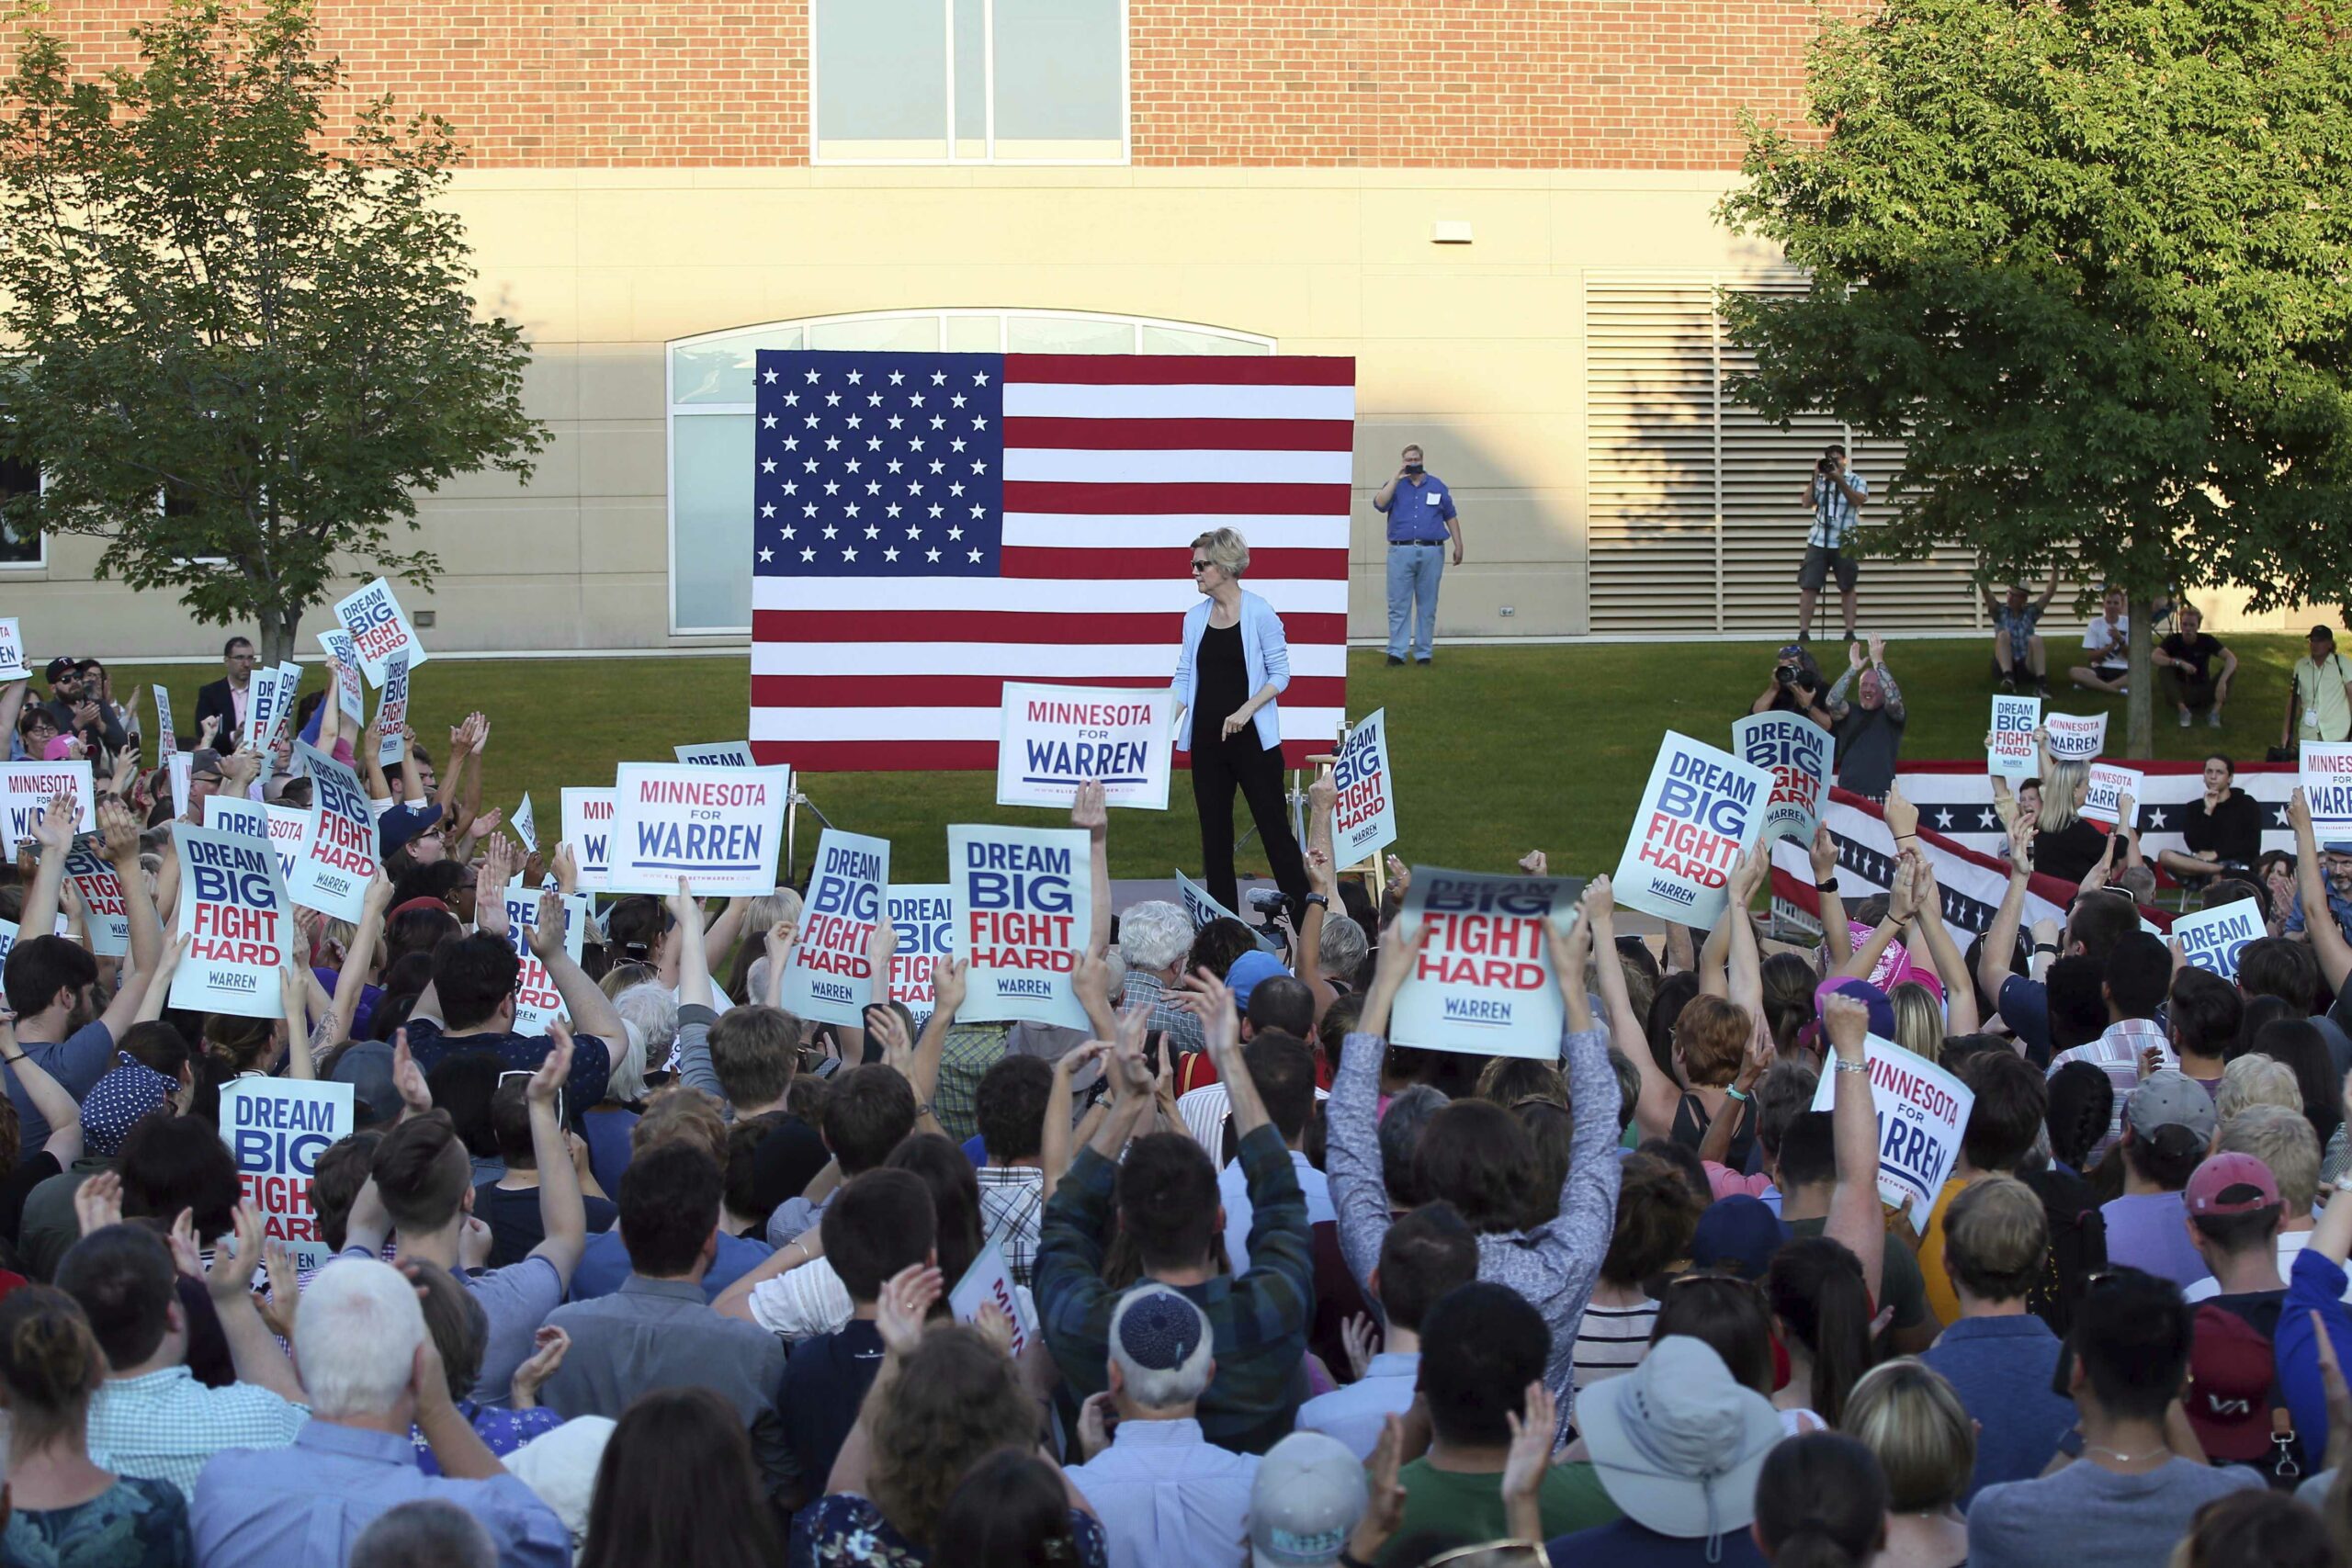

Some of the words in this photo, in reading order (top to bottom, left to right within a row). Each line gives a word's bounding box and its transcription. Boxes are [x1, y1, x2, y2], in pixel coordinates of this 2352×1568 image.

[343, 589, 385, 620] DREAM
[347, 603, 395, 637] BIG
[356, 618, 401, 652] FIGHT
[365, 634, 408, 662] HARD
[388, 660, 410, 679] DREAM
[385, 677, 407, 703] BIG
[382, 700, 406, 722] FIGHT
[1027, 701, 1151, 727] MINNESOTA
[1996, 716, 2032, 732] BIG
[1997, 703, 2033, 716] DREAM
[2049, 719, 2099, 732] MINNESOTA
[377, 721, 403, 736] HARD
[1079, 729, 1109, 739] FOR
[1341, 724, 1376, 761] REAM
[1746, 722, 1823, 757] DREAM
[1996, 731, 2033, 746] FIGHT
[2050, 735, 2098, 751] WARREN
[1026, 739, 1148, 777] WARREN
[1747, 742, 1822, 783] BIG
[1995, 746, 2031, 757] HARD
[2308, 755, 2352, 773] MINNES
[8, 774, 78, 794] MINNESOTA
[306, 755, 359, 795] DREAM
[1335, 746, 1381, 791] BIG
[1668, 751, 1757, 806] DREAM
[1765, 766, 1821, 802] GHT
[318, 778, 370, 827] BIG
[640, 781, 766, 807] MINNESOTA
[1335, 772, 1382, 818] FIGHT
[1657, 777, 1747, 840] BIG
[1767, 789, 1815, 819] ARD
[691, 810, 721, 820] FOR
[1338, 796, 1385, 834] HARD
[1767, 808, 1806, 823] WARREN
[318, 809, 373, 856] FIGHT
[638, 821, 763, 861] WARREN
[1351, 823, 1377, 844] WARREN
[1645, 812, 1740, 869] FIGHT
[187, 840, 269, 874] DREAM
[310, 840, 376, 877] HARD
[825, 847, 881, 883] DREAM
[967, 842, 1070, 874] DREAM
[1638, 842, 1727, 889] HARD
[193, 865, 277, 909] BIG
[316, 872, 351, 893] WARREN
[968, 872, 1073, 913] BIG
[1430, 879, 1559, 895] DREAM
[1651, 877, 1696, 903] WARREN
[813, 875, 879, 923] BIG
[1425, 893, 1553, 916] BIG
[194, 902, 279, 942] FIGHT
[802, 913, 877, 956] FIGHT
[970, 911, 1074, 948] FIGHT
[1419, 912, 1543, 960] FIGHT
[2179, 914, 2253, 953] DREAM
[190, 938, 281, 966] HARD
[797, 947, 872, 979] HARD
[971, 947, 1074, 973] HARD
[209, 971, 256, 989] WARREN
[998, 978, 1051, 995] WARREN
[1417, 954, 1545, 990] HARD
[811, 980, 853, 999] WARREN
[1445, 998, 1511, 1020] WARREN
[235, 1095, 335, 1133] DREAM
[1897, 1103, 1925, 1124] FOR
[235, 1129, 333, 1175] BIG
